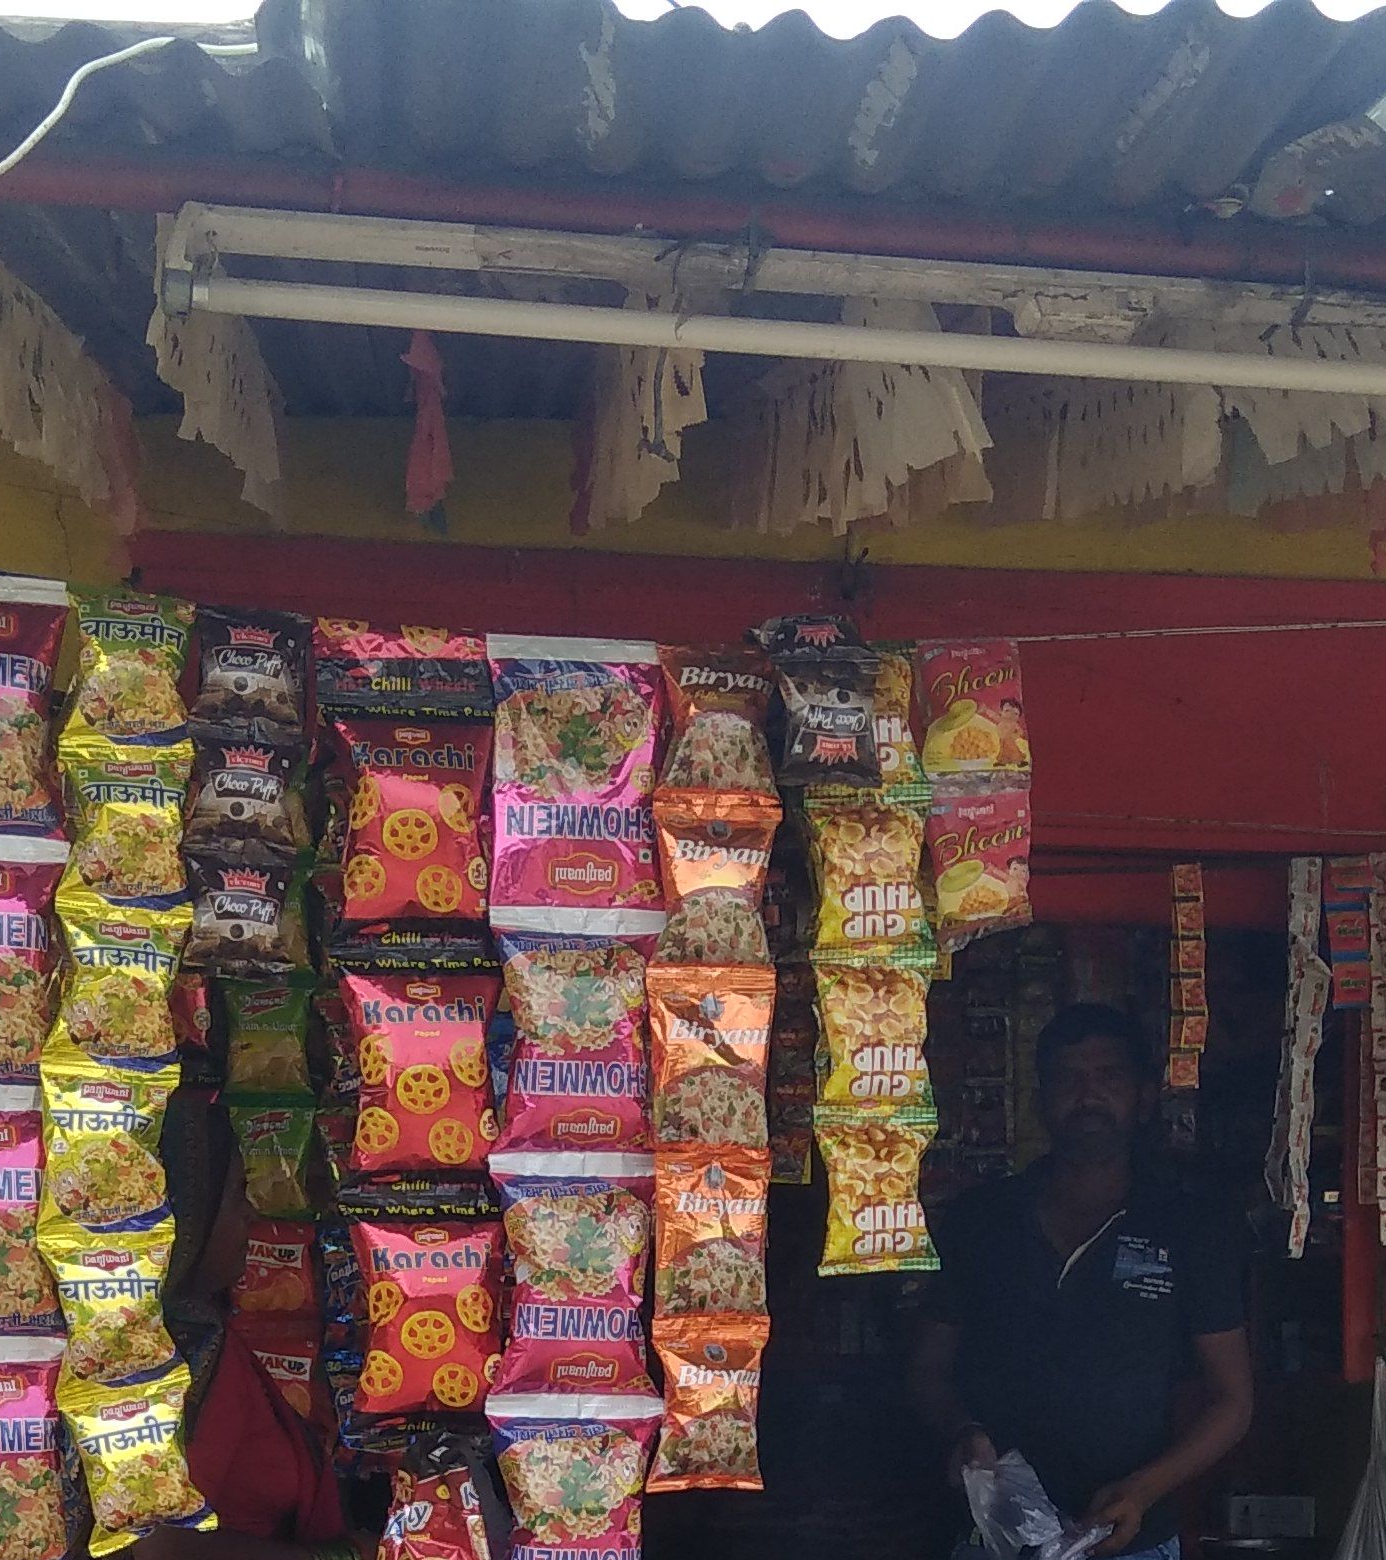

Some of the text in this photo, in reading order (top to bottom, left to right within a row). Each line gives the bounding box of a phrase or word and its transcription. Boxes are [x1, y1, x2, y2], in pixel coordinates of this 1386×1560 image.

[370, 676, 412, 692] Chilli
[380, 931, 422, 946] Chilli
[842, 914, 906, 939] GUP
[363, 995, 487, 1026] Karachi
[668, 1018, 771, 1050] Biryani
[849, 1073, 912, 1097] GUP
[853, 1231, 914, 1255] GUP
[371, 1242, 492, 1274] Karachi
[58, 1268, 162, 1302] चाऊमीन
[515, 1303, 642, 1342] HOWMEIN
